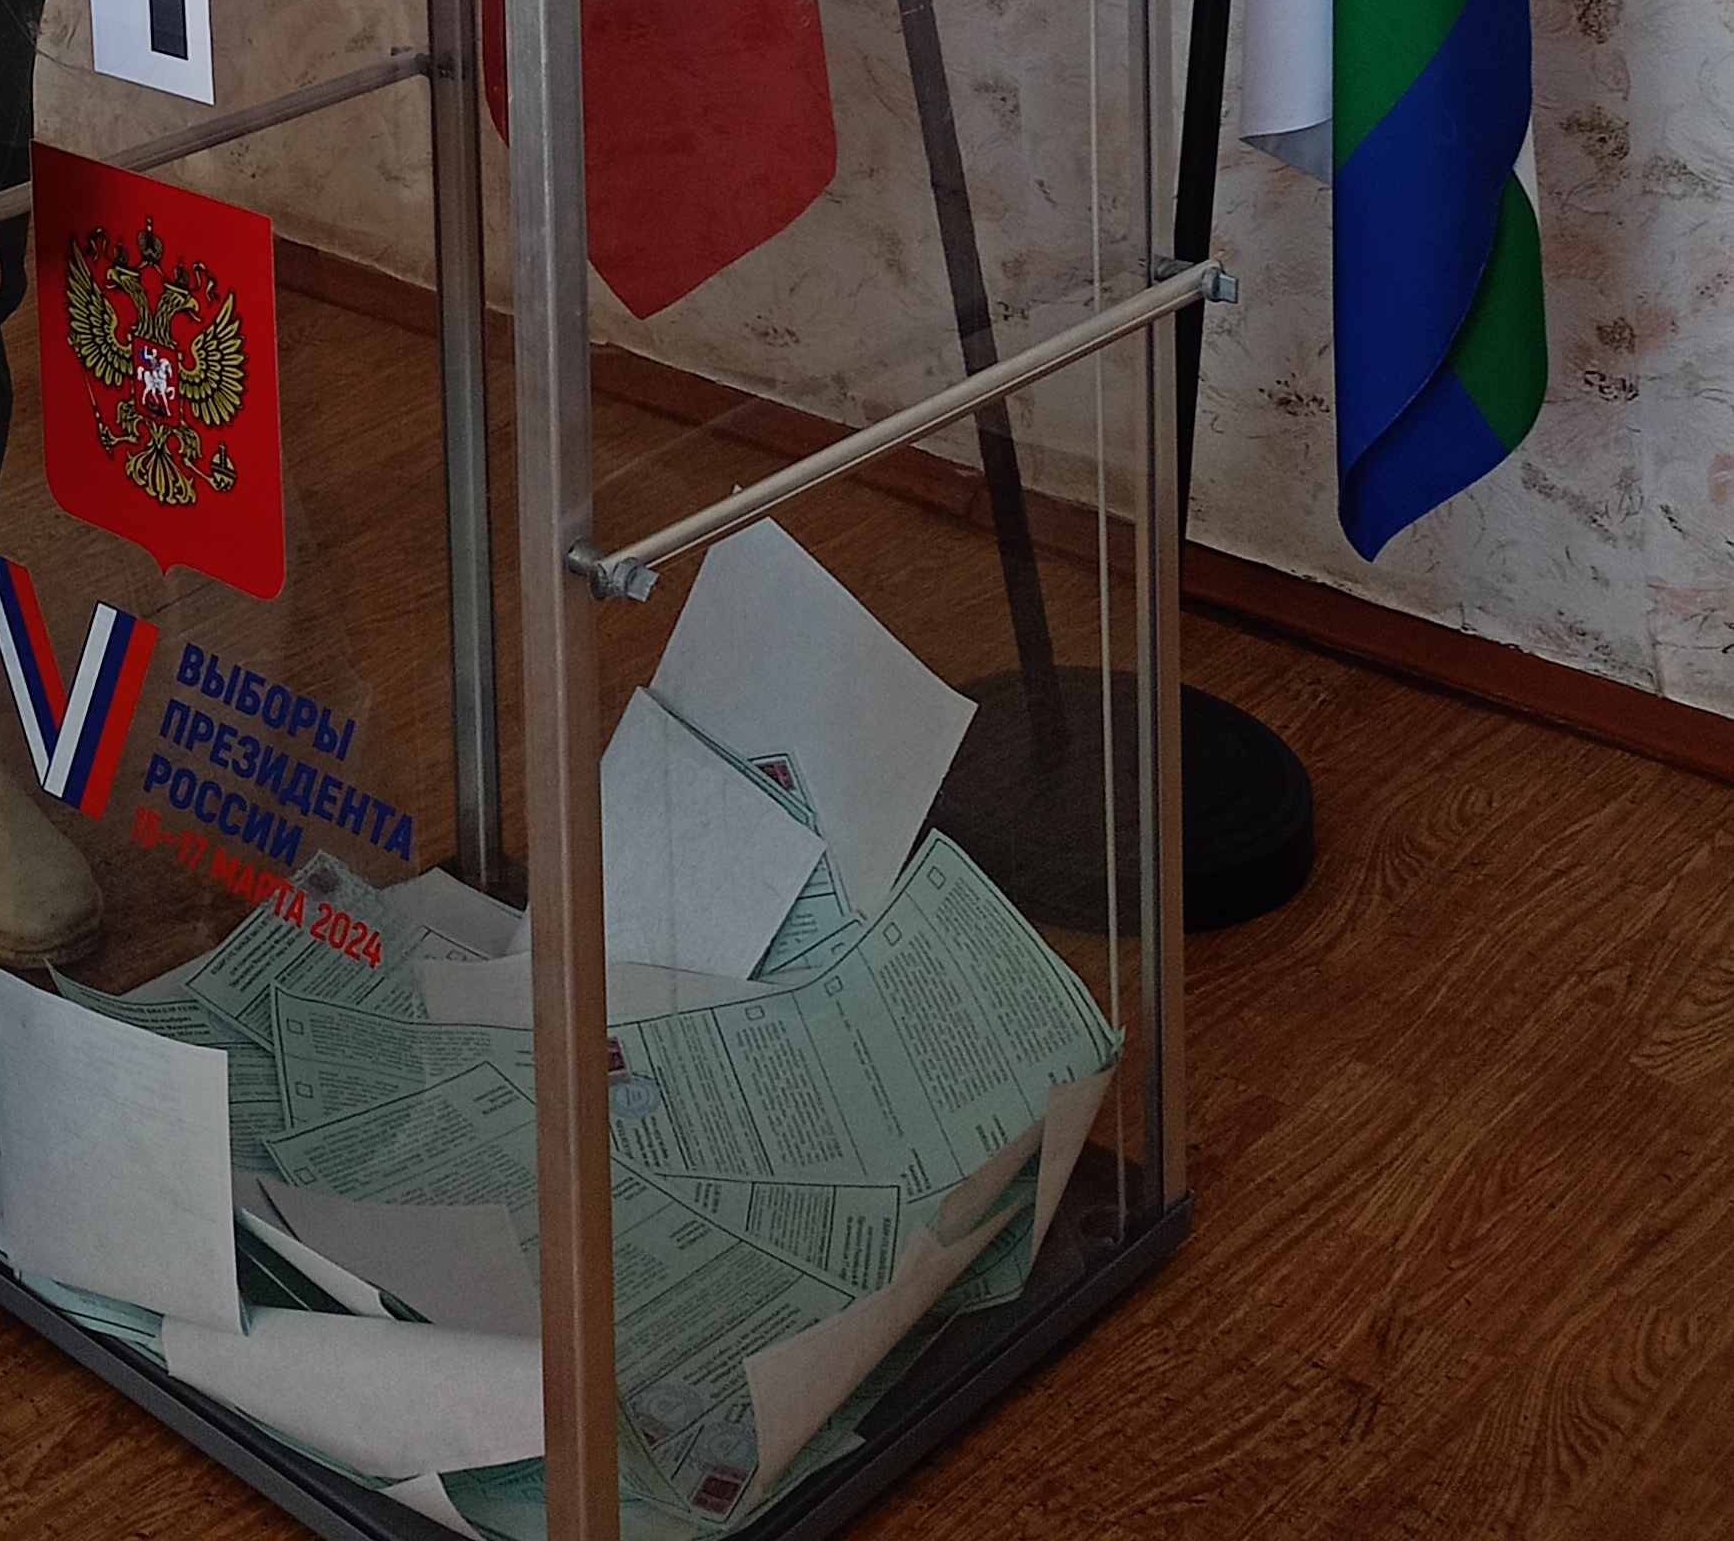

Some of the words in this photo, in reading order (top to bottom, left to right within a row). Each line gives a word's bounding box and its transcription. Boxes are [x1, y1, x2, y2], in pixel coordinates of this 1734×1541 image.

[176, 643, 357, 762] ВЫБОРЫ
[143, 754, 304, 867] РОССИИ
[160, 699, 414, 861] ПРЕЗИДЕНТА
[211, 847, 308, 929] МАРТА
[311, 902, 385, 969] 2024
